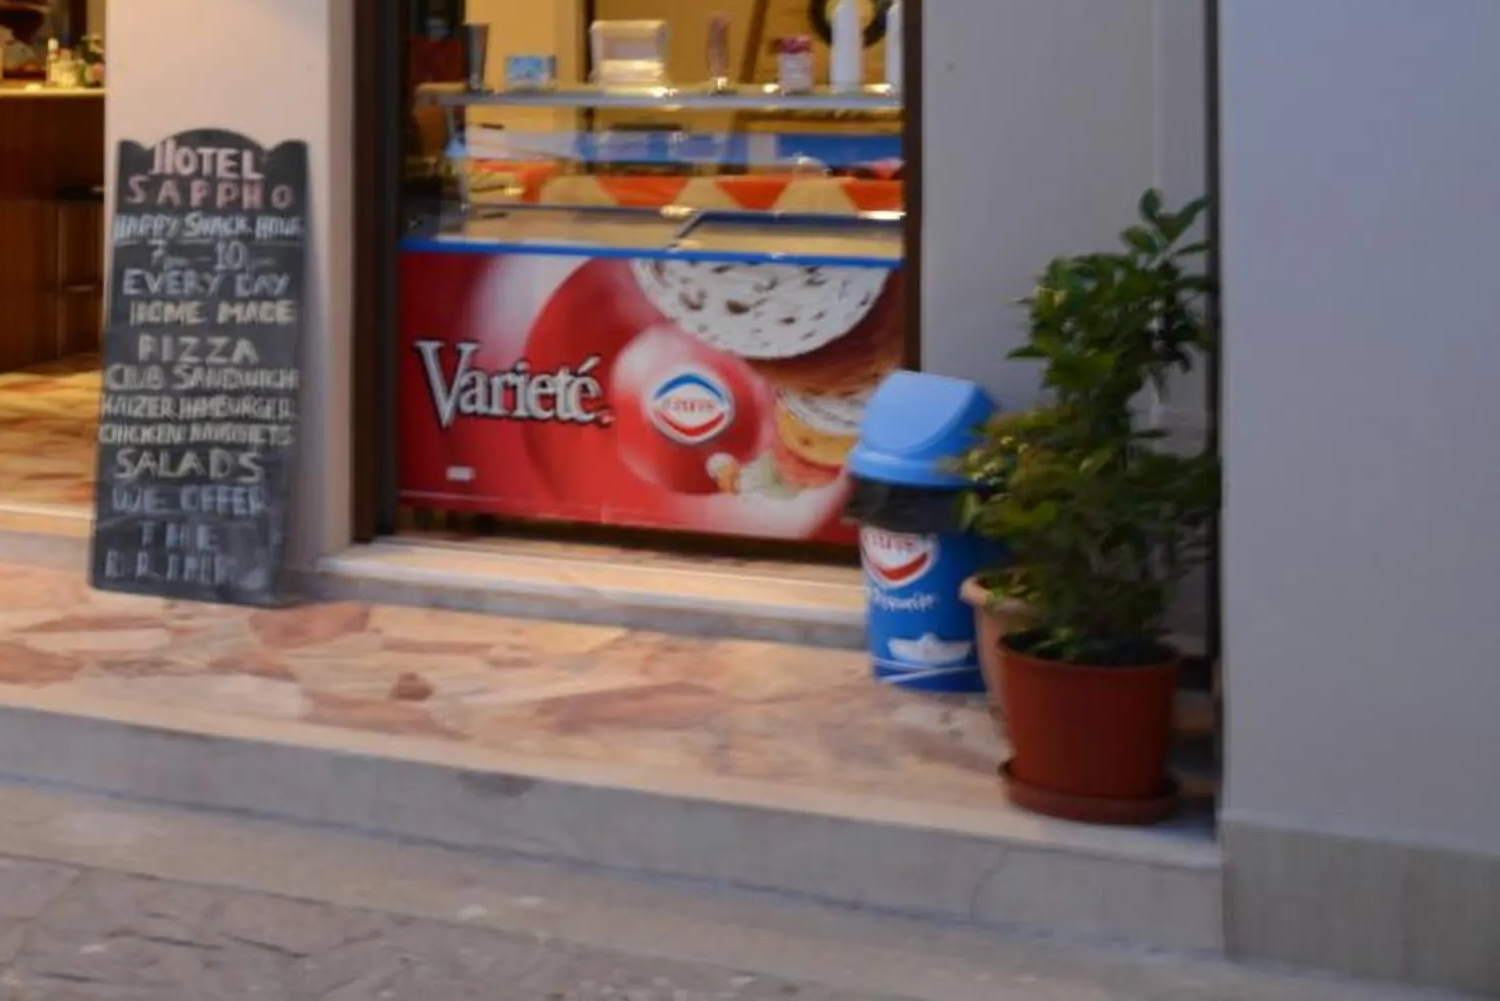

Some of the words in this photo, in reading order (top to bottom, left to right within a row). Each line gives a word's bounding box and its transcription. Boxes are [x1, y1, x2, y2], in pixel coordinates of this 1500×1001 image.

[148, 140, 266, 180] HOTEL
[125, 176, 293, 210] SAPPHO
[114, 213, 180, 242] HAPPY
[122, 267, 224, 296] EVERY
[138, 333, 260, 365] PIZZA
[106, 363, 167, 391] CLUB
[113, 448, 266, 482] SALADS
[111, 484, 171, 516] WE
